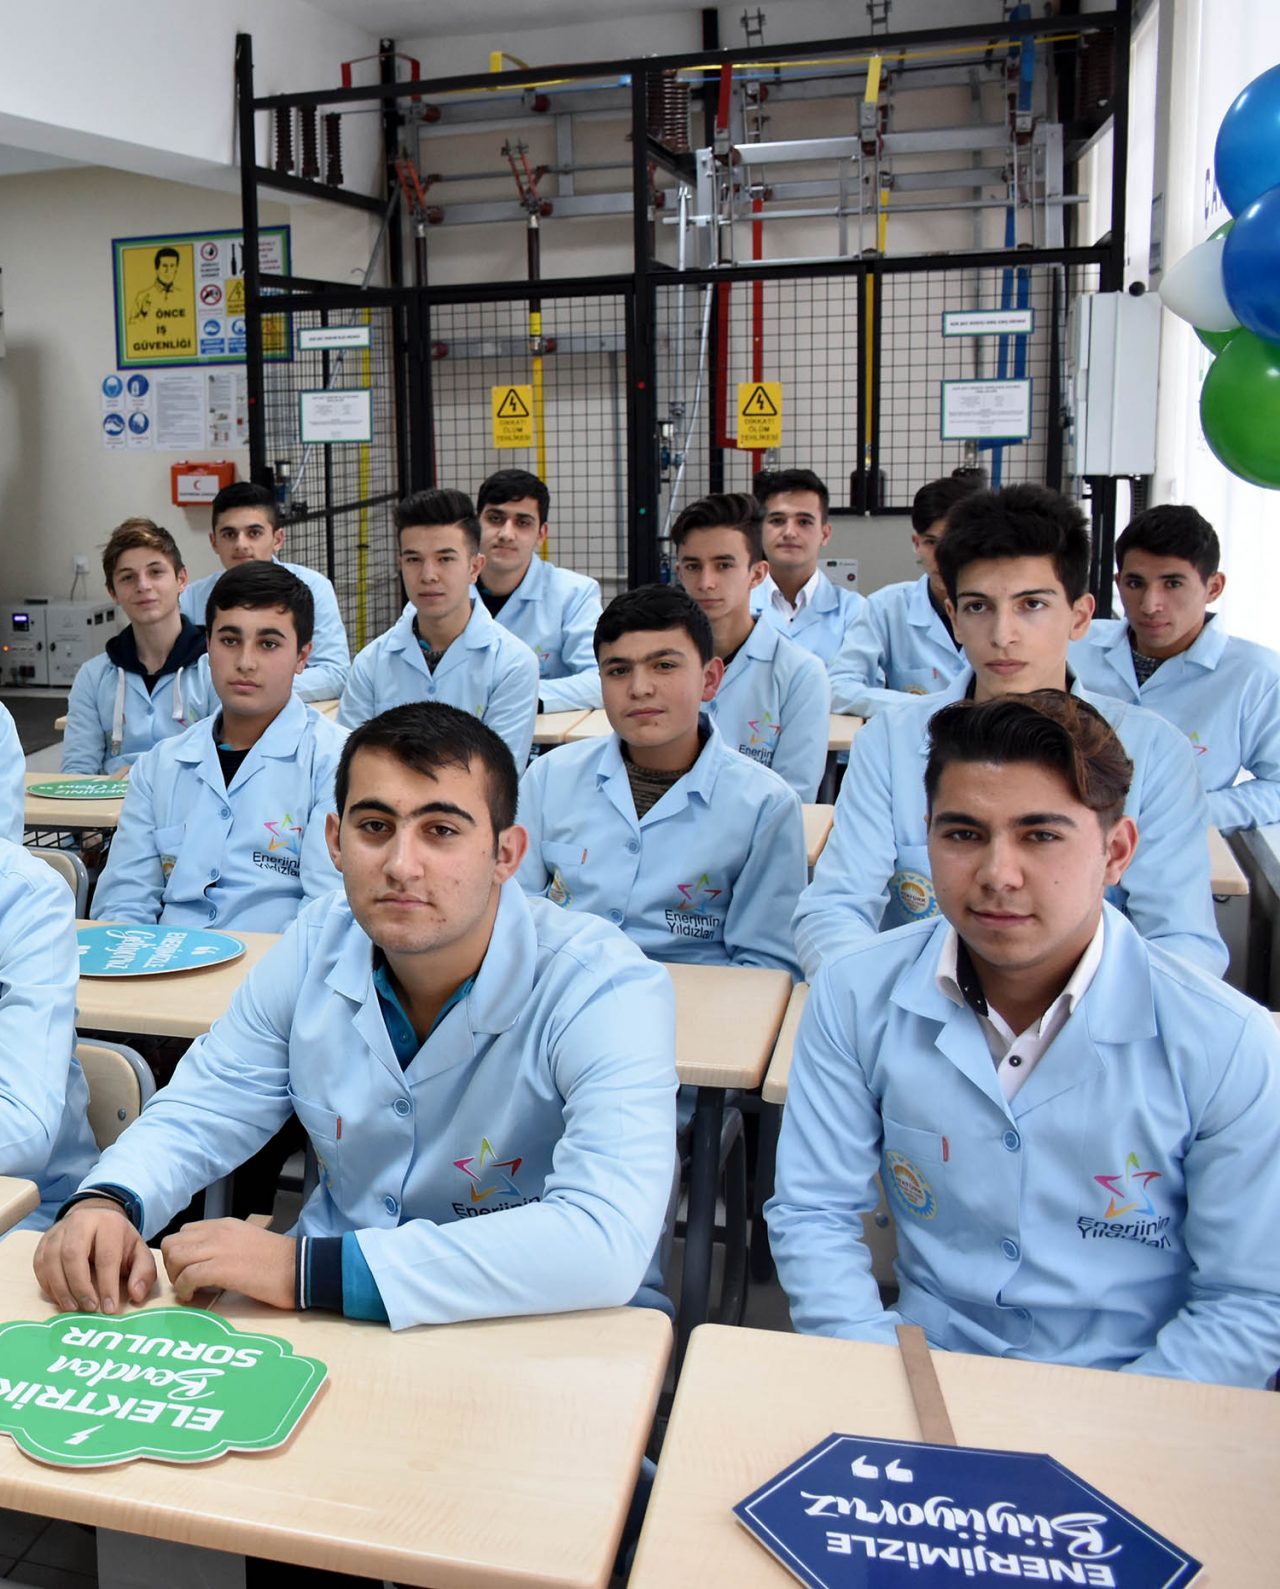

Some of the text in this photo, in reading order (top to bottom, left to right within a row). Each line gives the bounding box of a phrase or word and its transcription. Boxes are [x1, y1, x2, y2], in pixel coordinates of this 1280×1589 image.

[156, 307, 186, 320] ÖNCE
[133, 339, 191, 351] GÜVENLİĞİ
[253, 851, 300, 868] Enerjini
[61, 1326, 264, 1368] SORULUR
[47, 1355, 225, 1400] Benden
[800, 1490, 1122, 1559] Büyüyoruz
[826, 1531, 1116, 1587] ENERJİMİZLE
